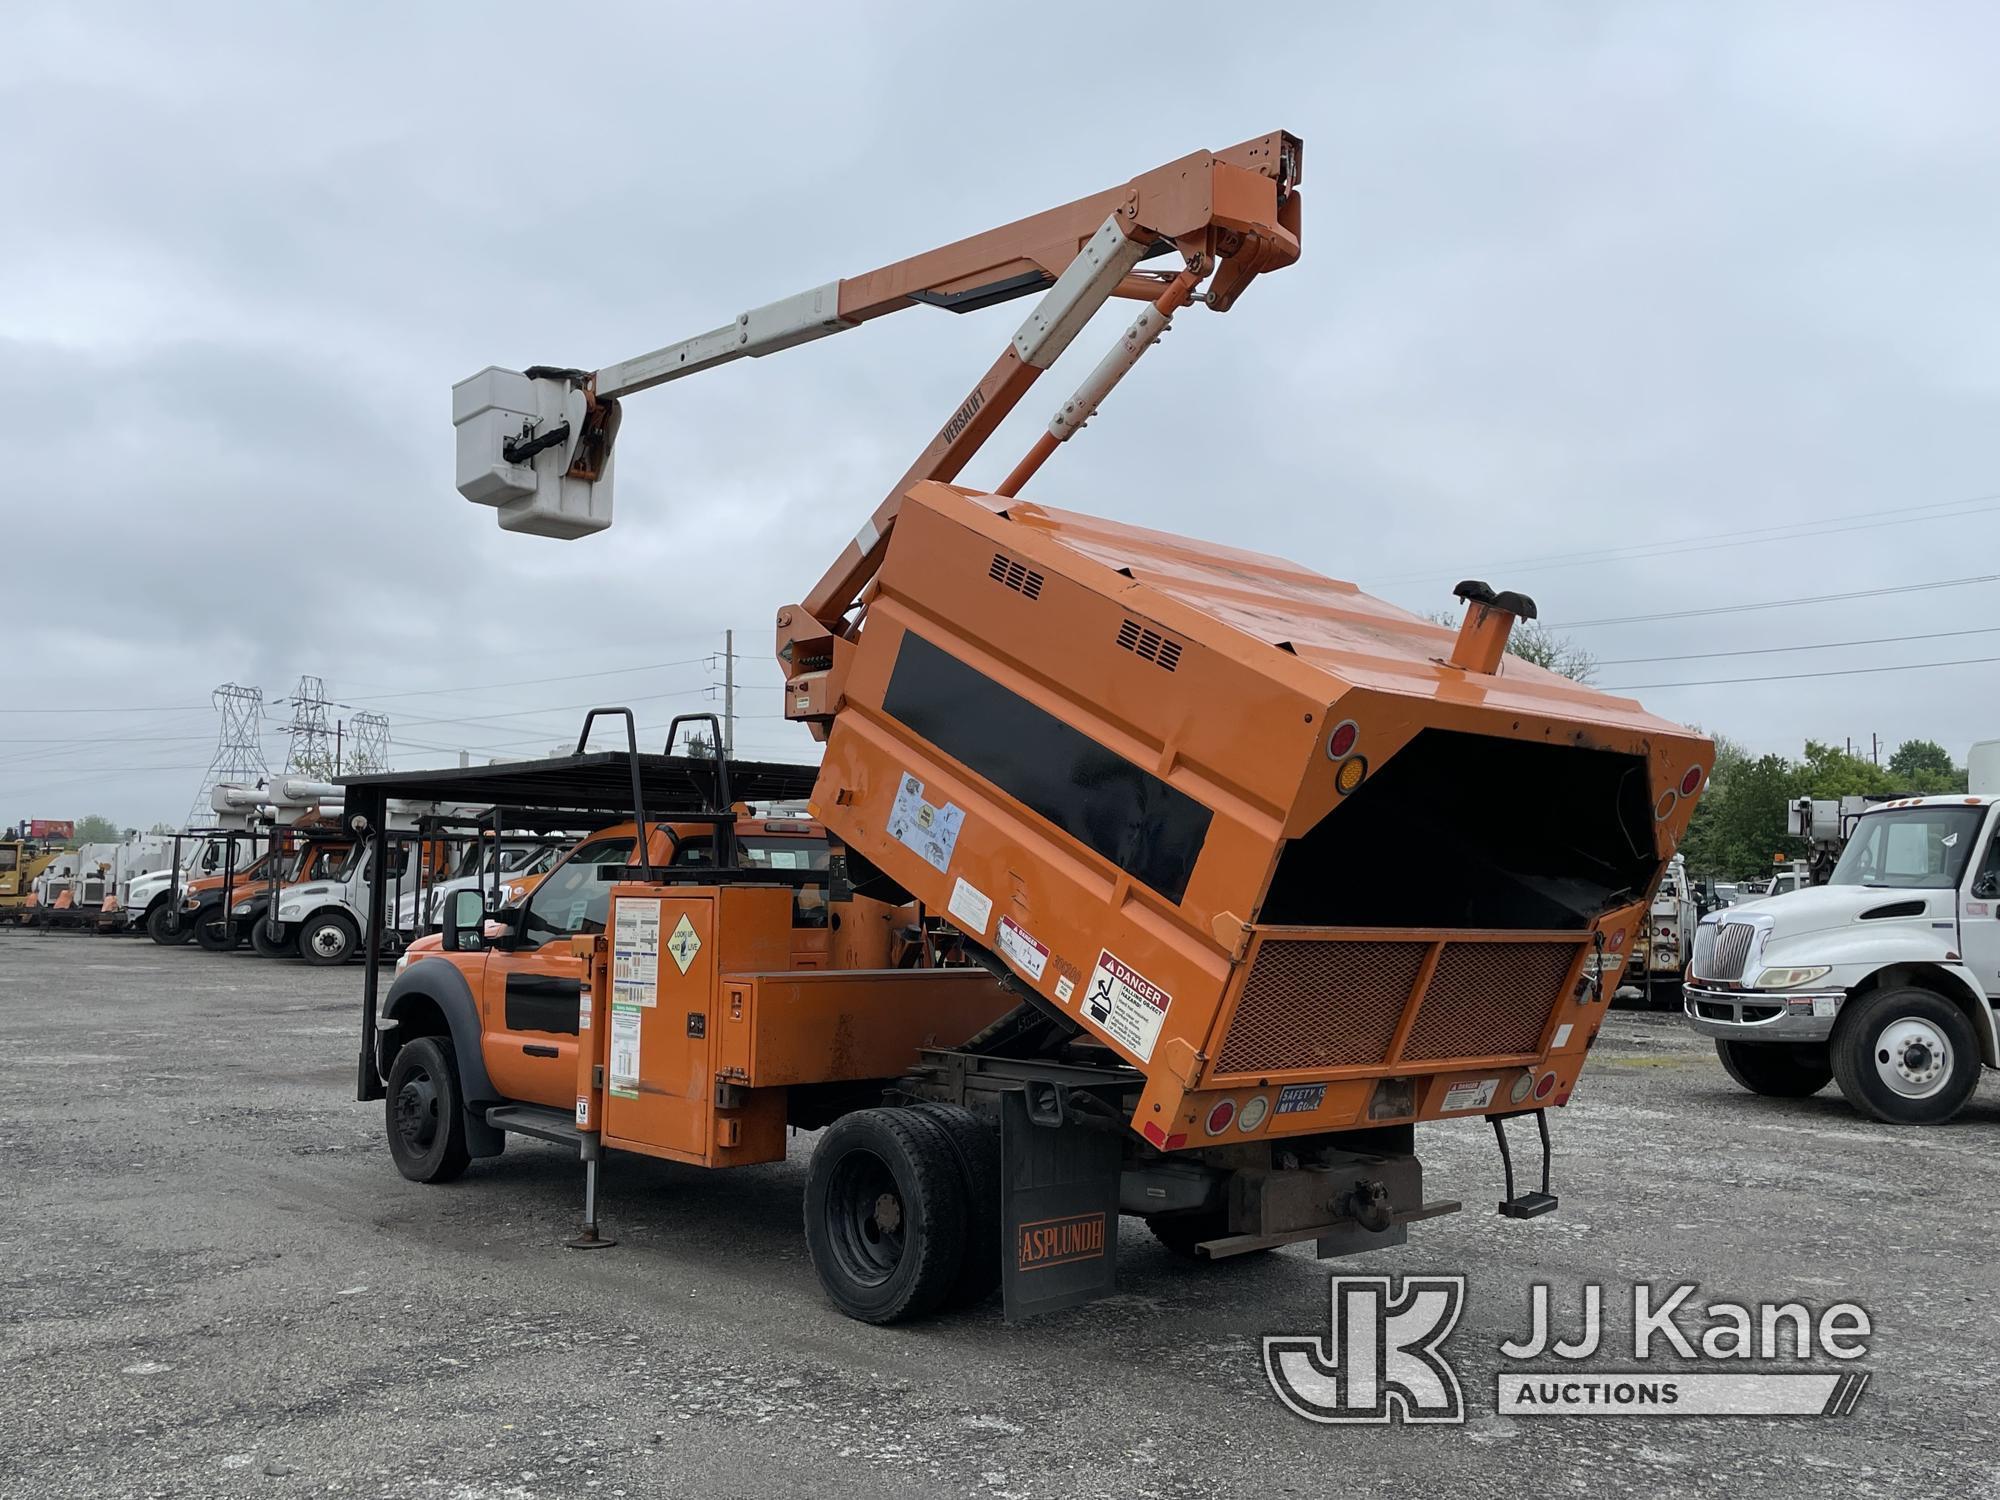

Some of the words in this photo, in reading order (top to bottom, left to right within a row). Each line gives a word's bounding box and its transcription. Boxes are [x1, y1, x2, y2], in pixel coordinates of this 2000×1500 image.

[943, 387, 985, 444] VERSALIFT
[675, 930, 687, 938] LOOK
[687, 930, 694, 938] UP
[1018, 929, 1038, 948] DANGER
[671, 943, 680, 951] AND
[687, 943, 698, 951] LIVE
[1116, 966, 1161, 1004] DANGER
[1121, 992, 1141, 1008] HAZARD!
[1123, 986, 1142, 1001] FALLING
[1143, 1001, 1161, 1016] OBJECT
[1282, 1088, 1316, 1102] SAFETY
[1279, 1102, 1295, 1113] MY
[1022, 1220, 1103, 1263] ASPLUNDH
